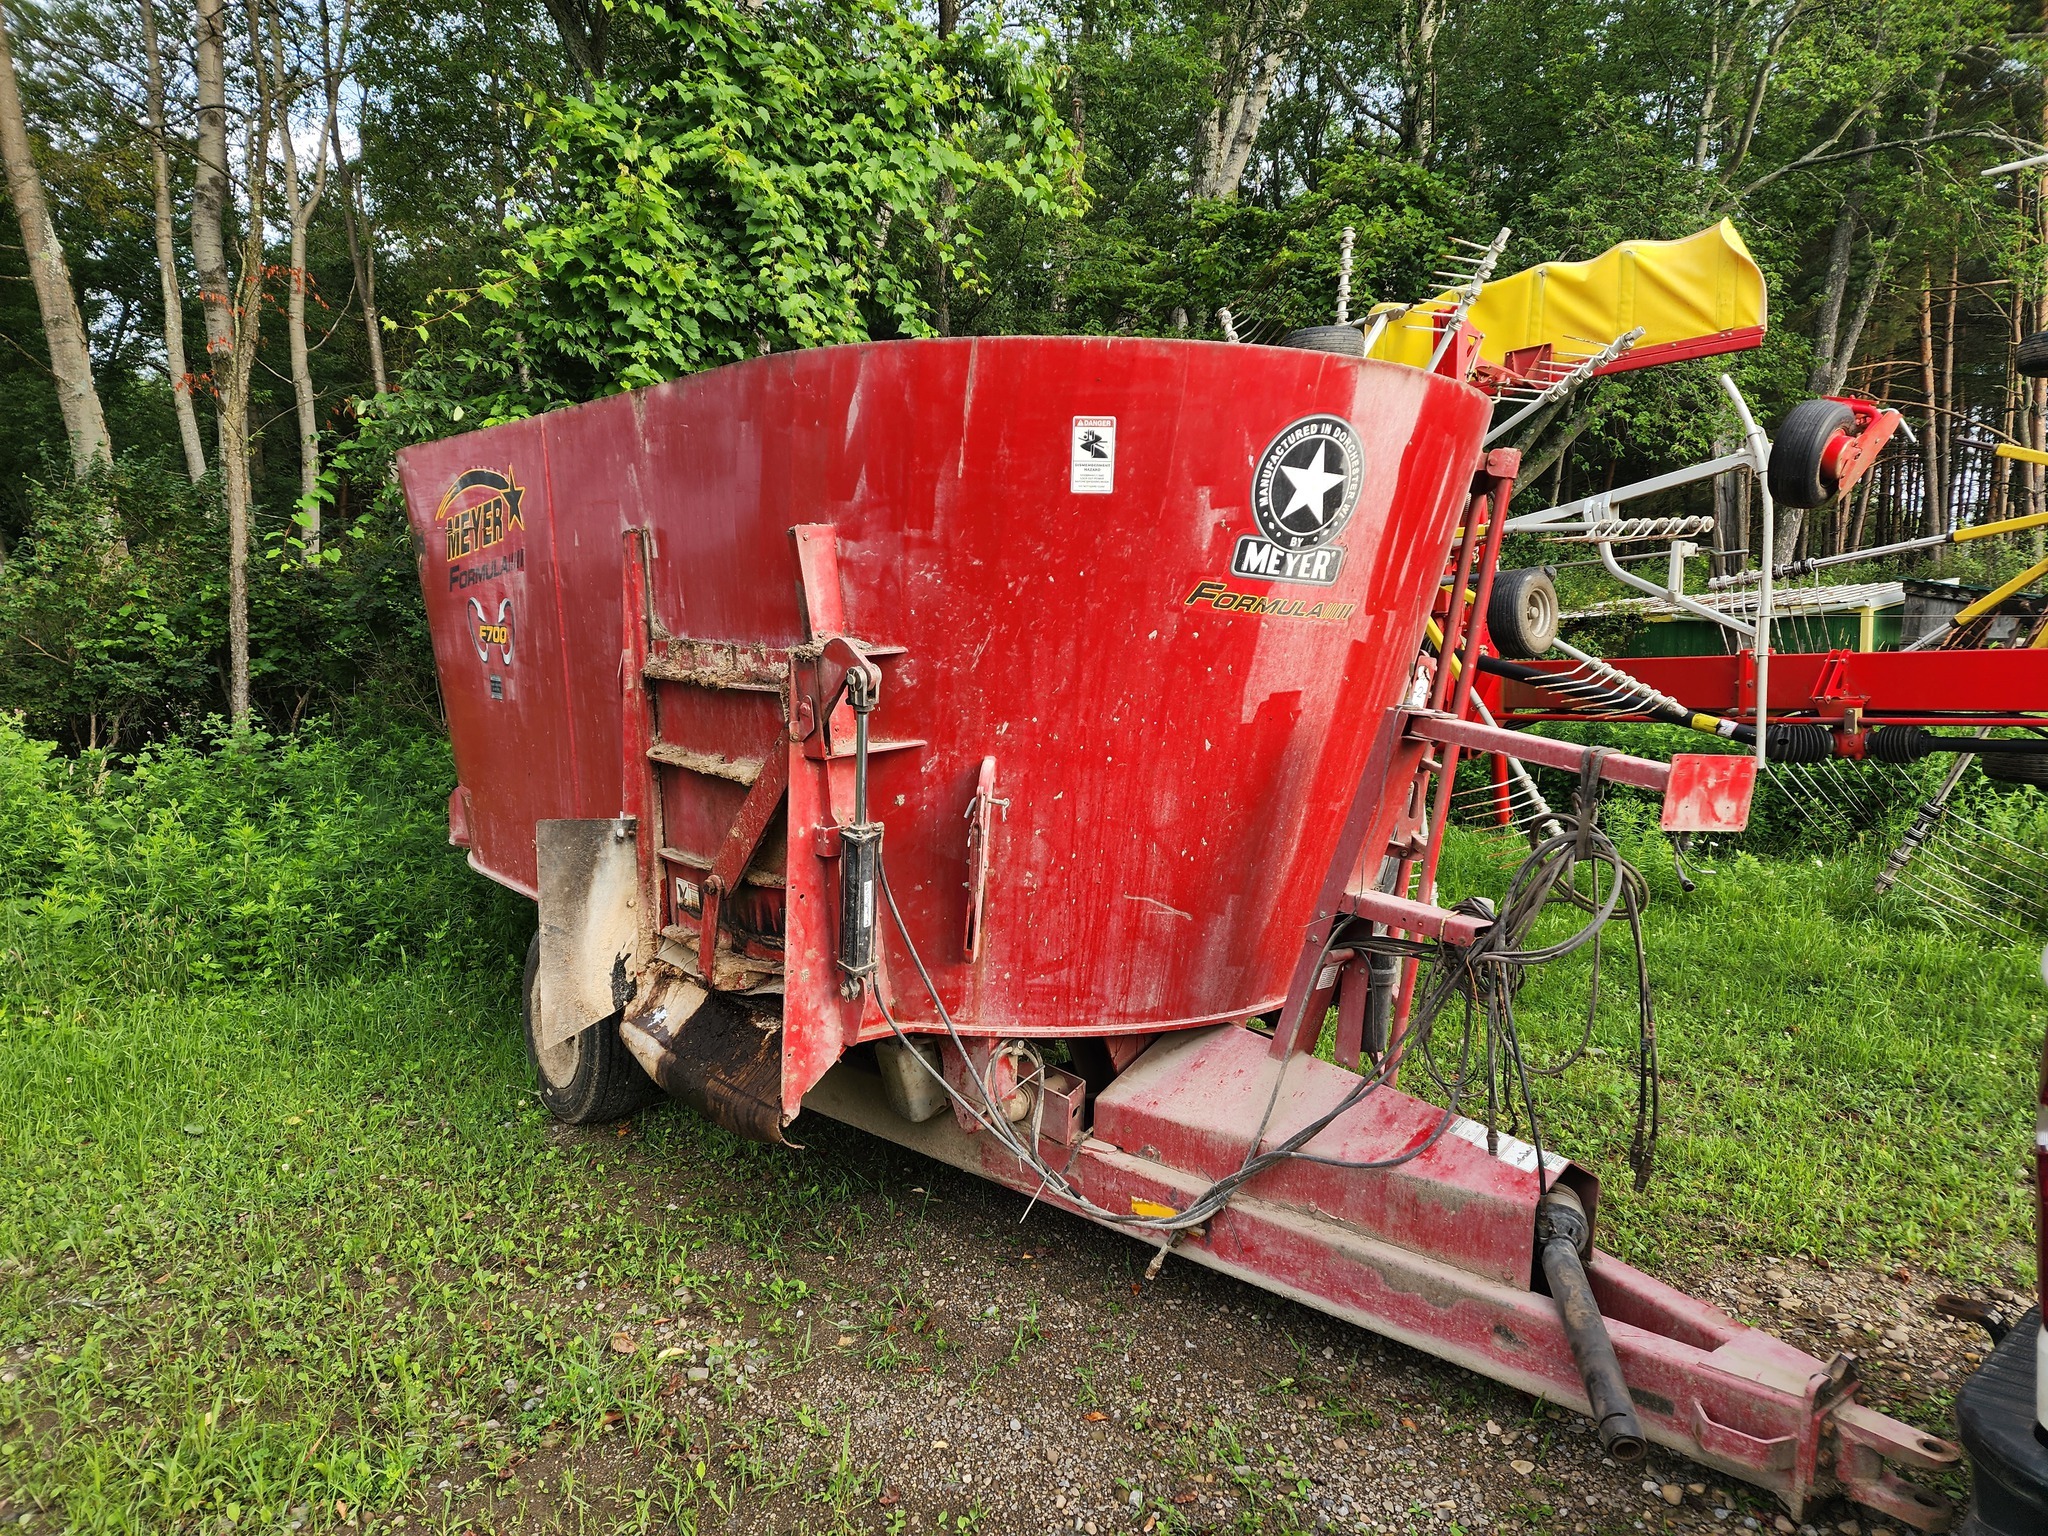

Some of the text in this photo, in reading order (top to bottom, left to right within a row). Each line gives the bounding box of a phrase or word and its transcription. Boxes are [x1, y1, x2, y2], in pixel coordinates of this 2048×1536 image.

[1259, 423, 1360, 518] MANUFACTURED IN DORCHESTER WI
[446, 496, 504, 562] MEYER
[1290, 537, 1304, 547] BY
[1241, 542, 1332, 580] MEYER
[479, 625, 507, 644] F700
[1417, 686, 1424, 698] 2
